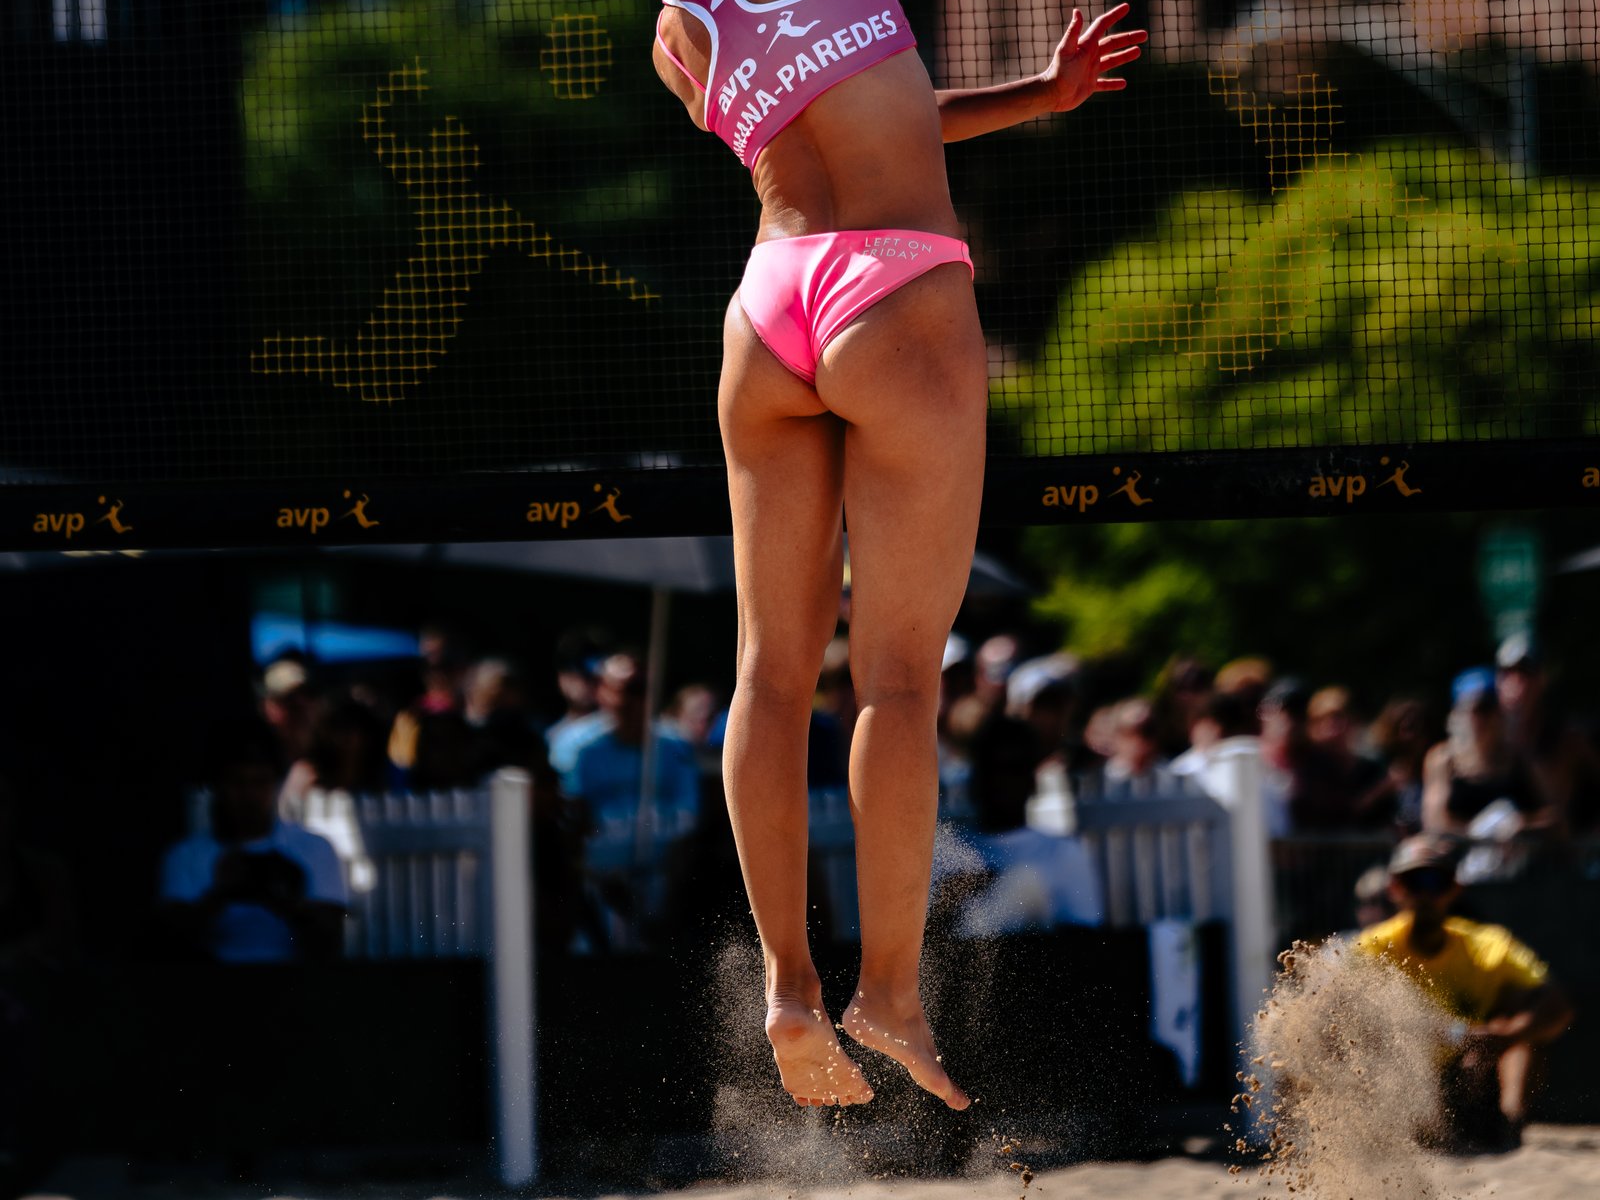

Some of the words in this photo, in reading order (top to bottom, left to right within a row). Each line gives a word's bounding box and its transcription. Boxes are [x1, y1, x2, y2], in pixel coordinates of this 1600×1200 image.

[718, 58, 757, 116] avp
[862, 248, 919, 261] FRIDAY
[864, 237, 900, 248] LEFT
[908, 240, 932, 254] ON
[1041, 485, 1099, 512] avp
[1309, 475, 1366, 503] avp
[33, 512, 85, 539] avp
[277, 506, 330, 534] avp
[527, 501, 581, 528] avp
